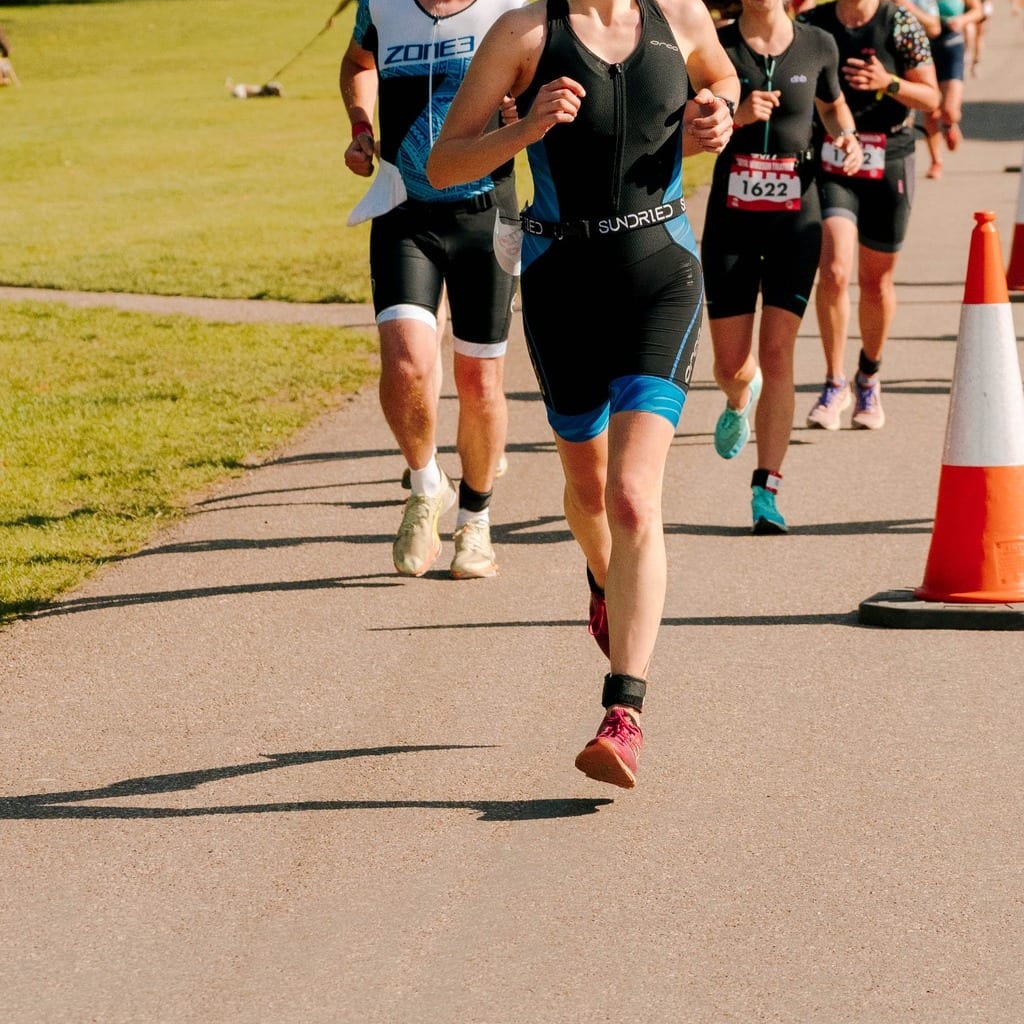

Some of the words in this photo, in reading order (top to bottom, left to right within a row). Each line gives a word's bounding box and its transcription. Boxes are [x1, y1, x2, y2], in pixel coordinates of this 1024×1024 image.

[384, 36, 475, 65] ZONE3
[650, 40, 679, 52] orca
[834, 149, 872, 165] 12
[742, 180, 788, 196] 1622
[598, 204, 674, 234] SUNDRIED
